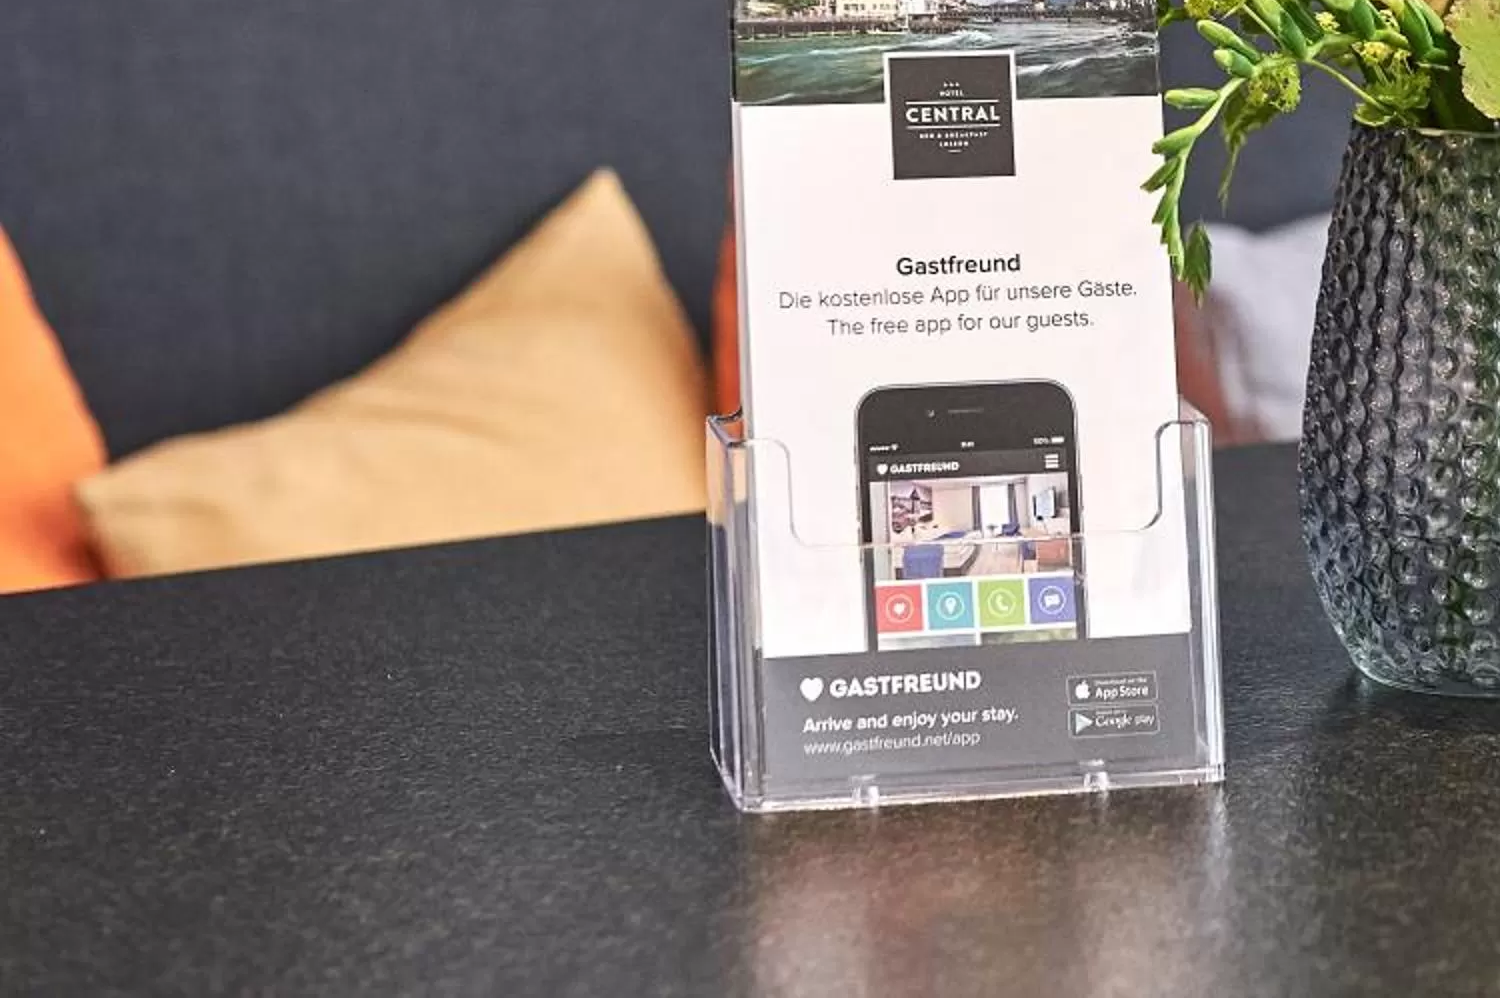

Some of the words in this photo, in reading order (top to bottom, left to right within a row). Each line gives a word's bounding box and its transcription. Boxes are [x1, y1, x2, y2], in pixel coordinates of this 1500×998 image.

[905, 105, 1000, 123] CENTRAL
[896, 253, 1021, 276] Gastfreund
[778, 291, 813, 309] Die
[818, 288, 925, 308] kostenlose
[930, 285, 970, 306] App
[975, 283, 1001, 302] für
[1006, 284, 1073, 301] unsere
[1077, 279, 1138, 298] Gäste.
[826, 318, 865, 337] The
[870, 317, 909, 335] free
[915, 315, 953, 336] app
[957, 313, 983, 332] for
[989, 314, 1022, 330] our
[1025, 310, 1096, 334] guests.
[829, 670, 983, 699] GASTFREUND
[1095, 686, 1119, 701] App
[1120, 685, 1149, 698] Store
[803, 716, 853, 734] Arrive
[856, 713, 888, 731] and
[891, 709, 937, 731] enjoy
[940, 709, 978, 728] your
[981, 704, 1020, 725] stay.
[803, 731, 982, 756] www.gastfreund.net/app
